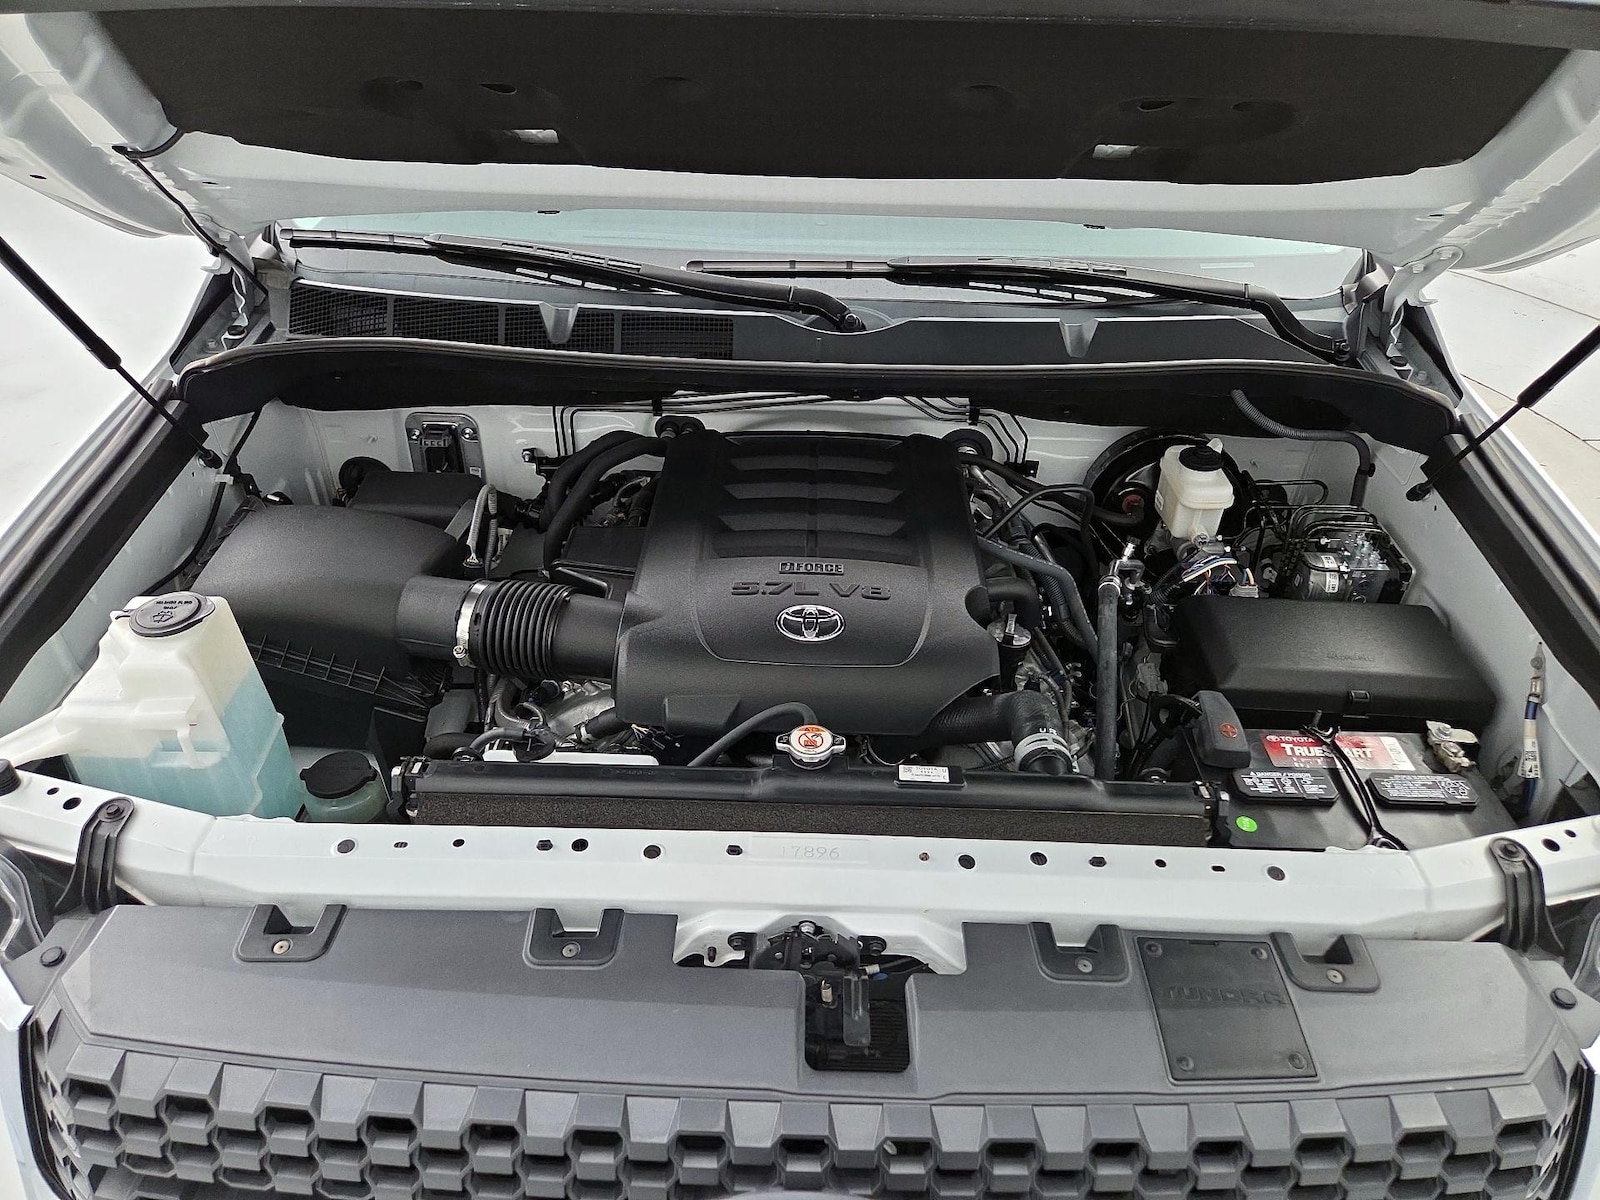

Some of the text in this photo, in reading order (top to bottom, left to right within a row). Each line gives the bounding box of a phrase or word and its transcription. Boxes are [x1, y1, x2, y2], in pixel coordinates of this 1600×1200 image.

[731, 581, 892, 600] 5.7L V8
[1279, 735, 1315, 743] TOYOTA
[1281, 743, 1373, 758] TRUESART
[781, 845, 840, 860] 17896
